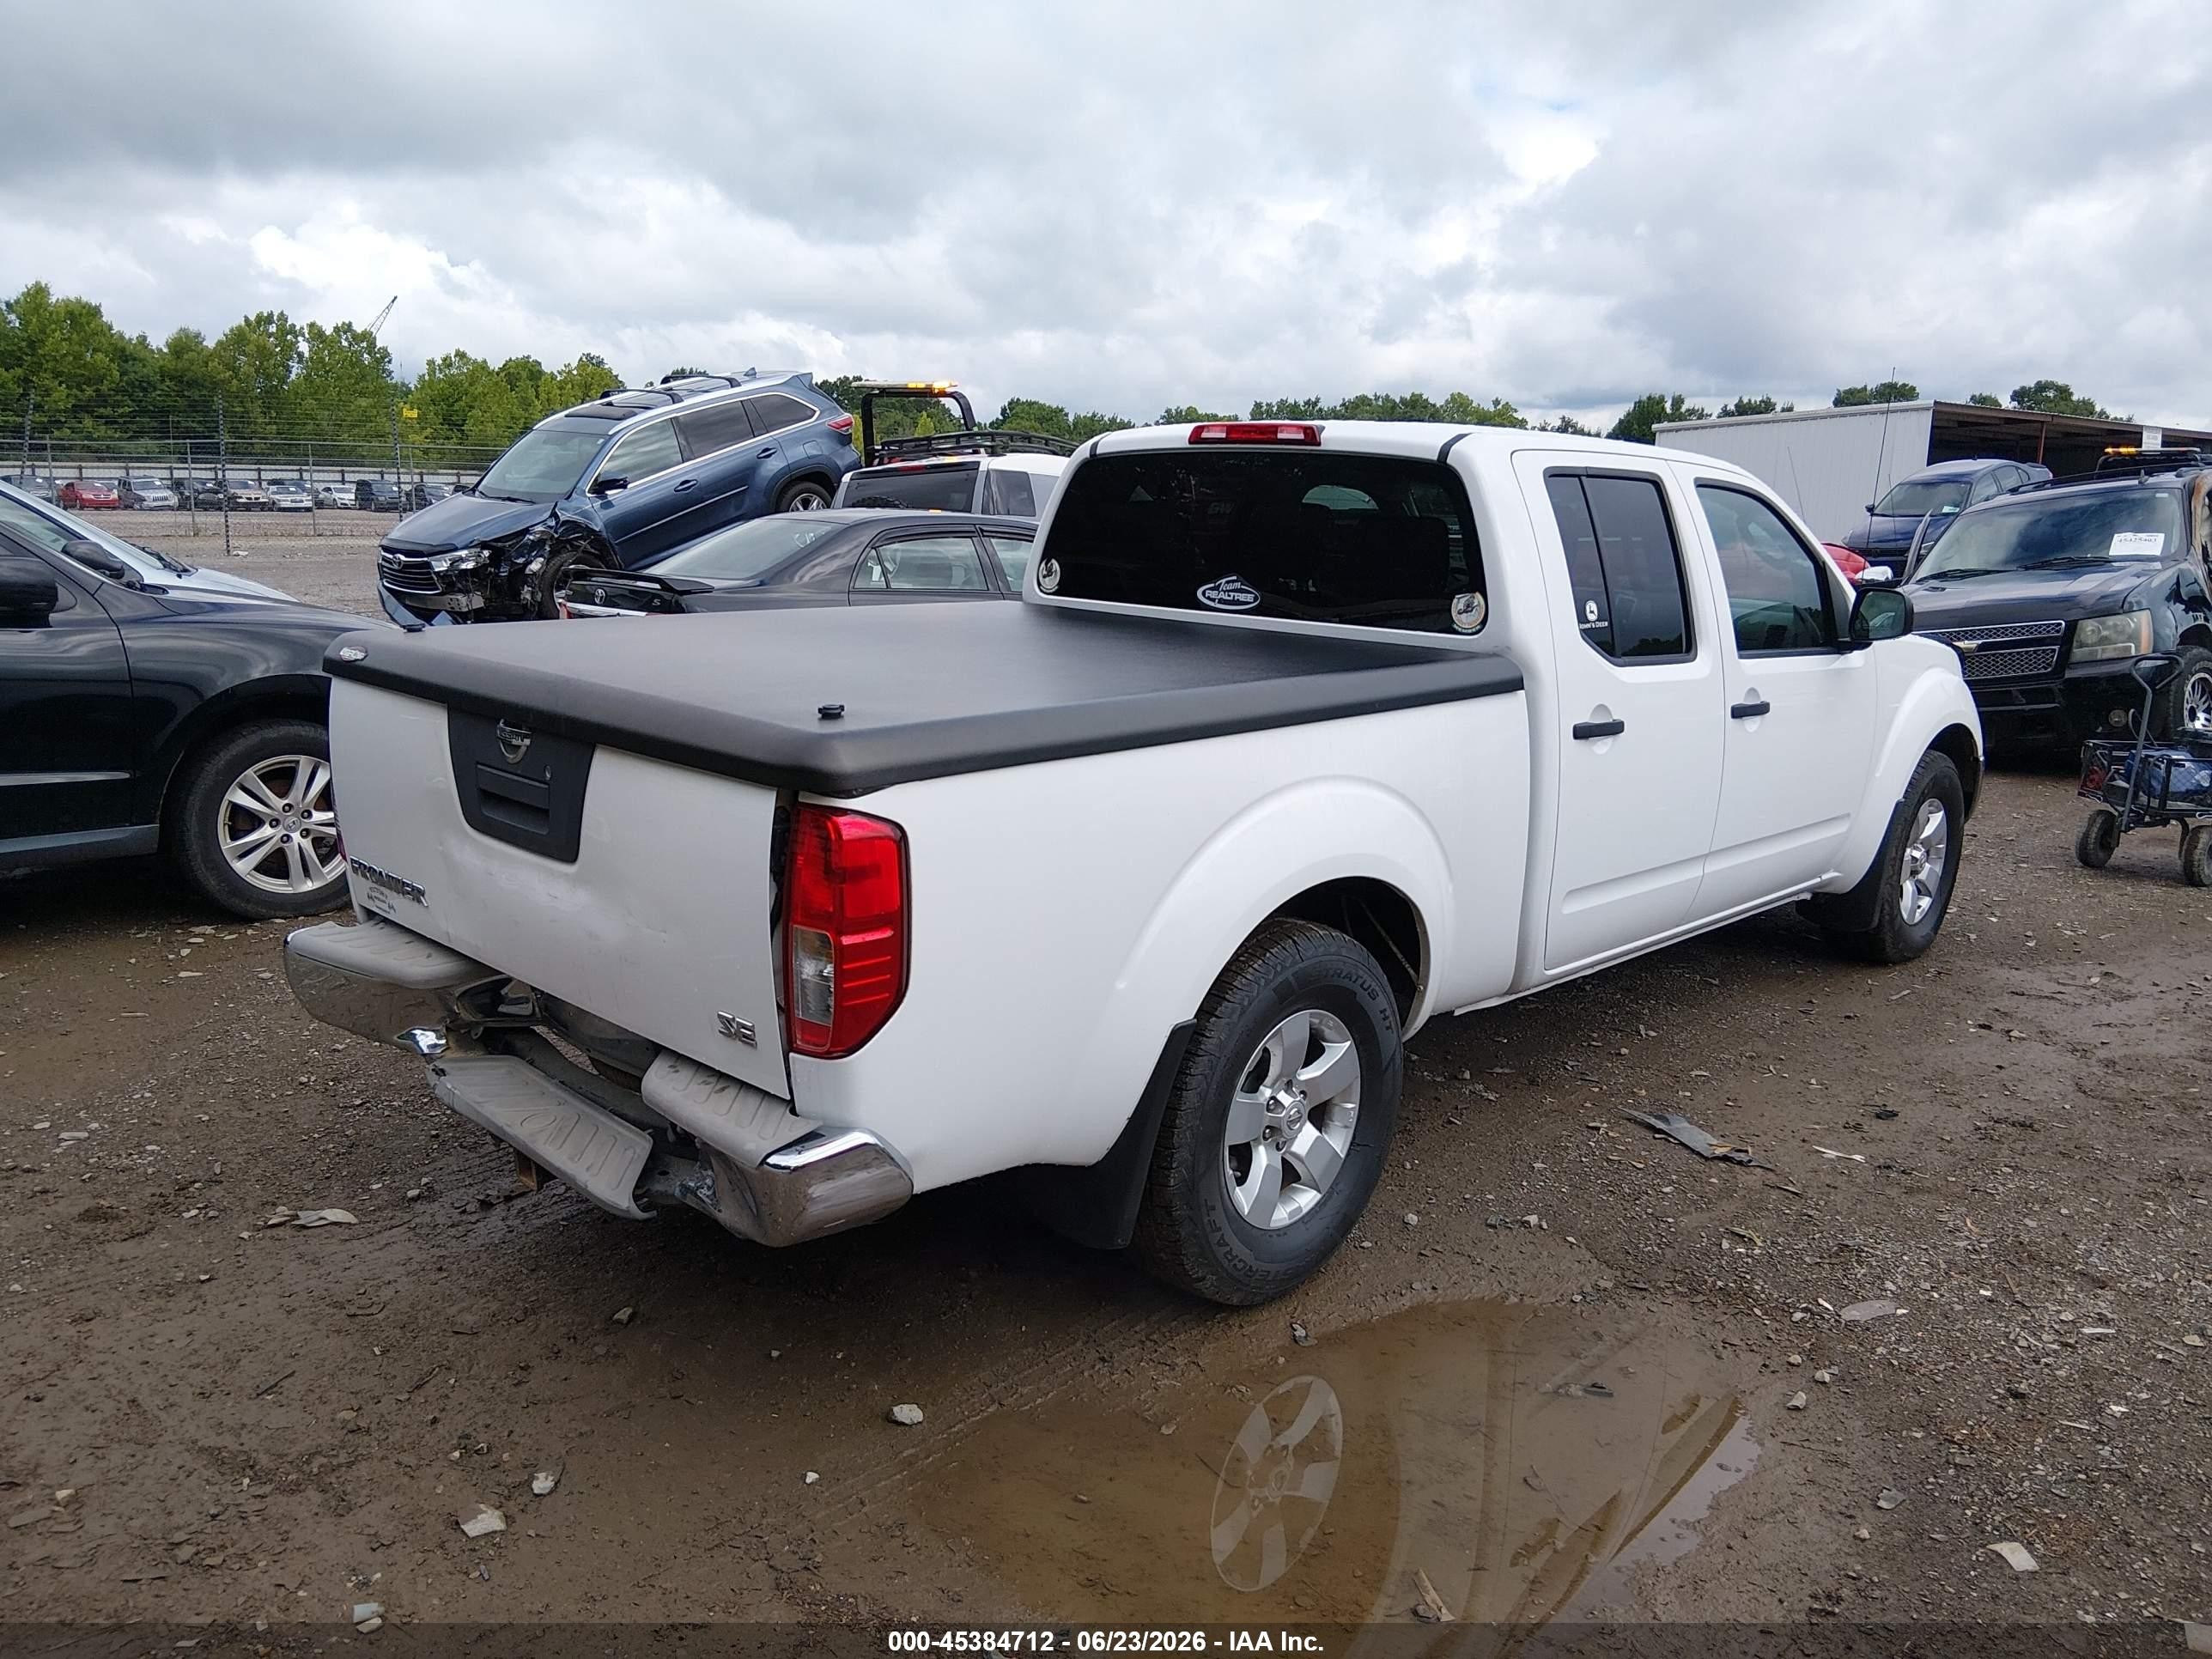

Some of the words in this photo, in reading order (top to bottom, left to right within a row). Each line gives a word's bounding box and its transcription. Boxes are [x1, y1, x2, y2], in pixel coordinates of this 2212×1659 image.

[1205, 590, 1255, 602] REALTREE
[1216, 575, 1241, 592] Team
[349, 855, 428, 907] FRONTIER
[717, 1011, 757, 1049] SE
